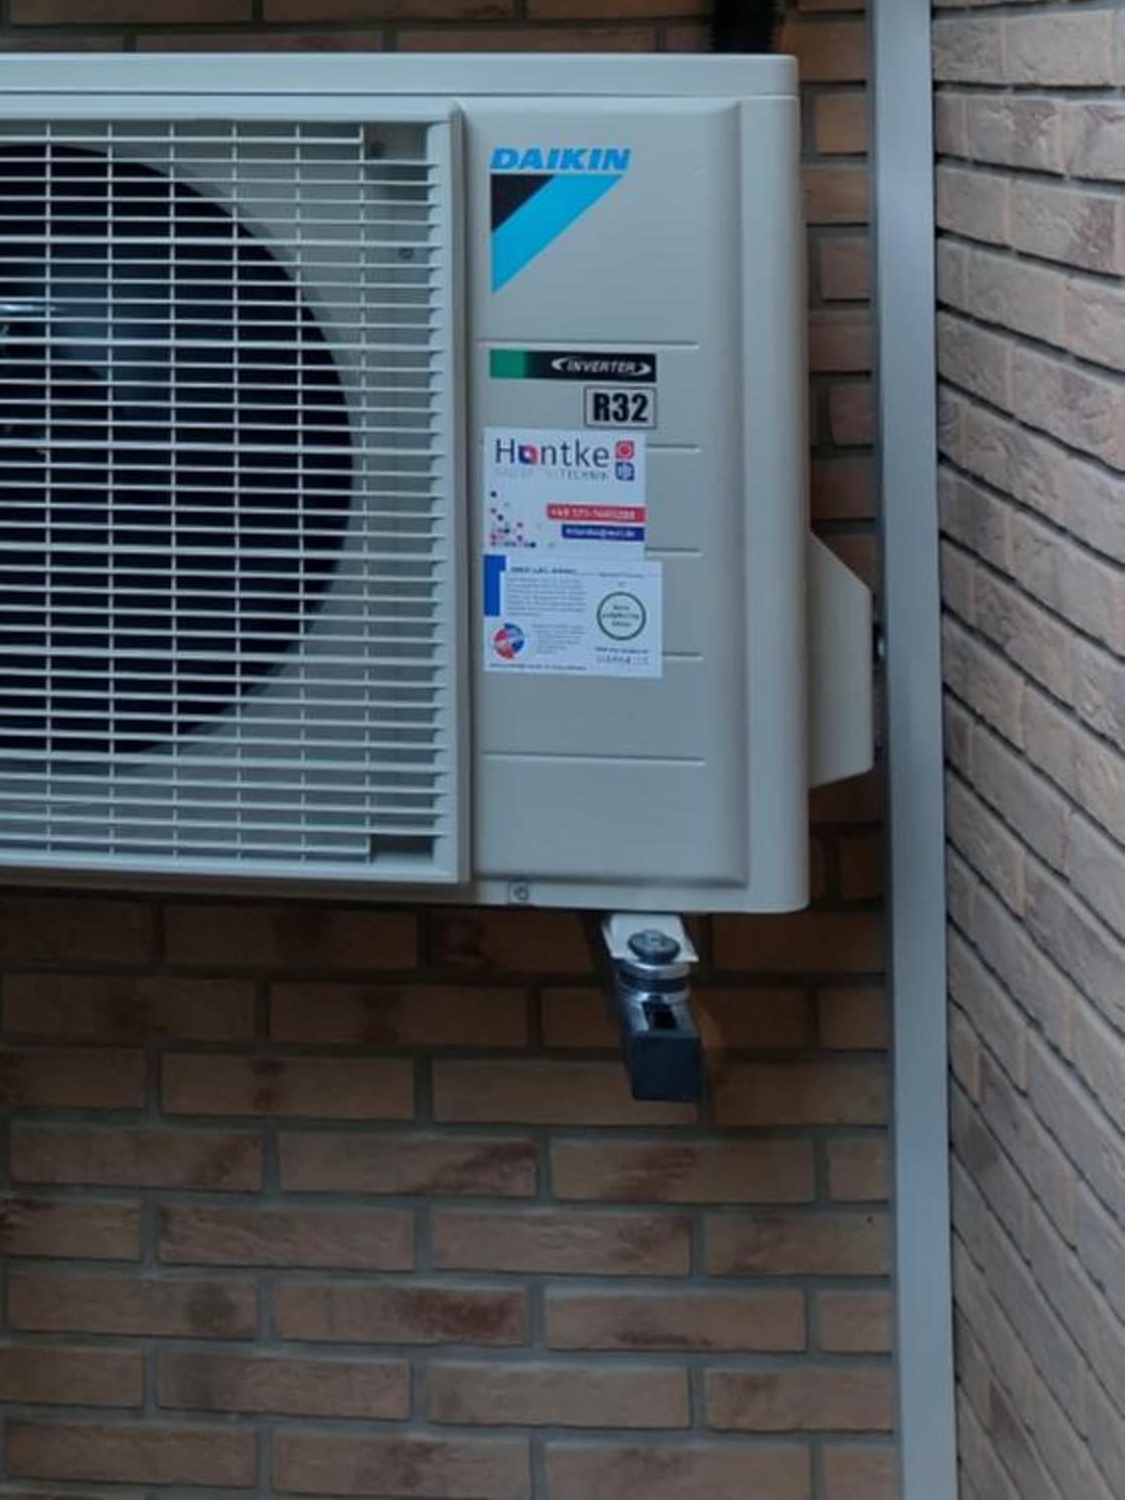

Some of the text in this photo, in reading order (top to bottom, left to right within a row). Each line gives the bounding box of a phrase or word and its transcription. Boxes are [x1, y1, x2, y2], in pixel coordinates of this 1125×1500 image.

[490, 147, 631, 170] DAIKIN
[566, 356, 637, 373] INVERTER
[592, 393, 649, 423] R32
